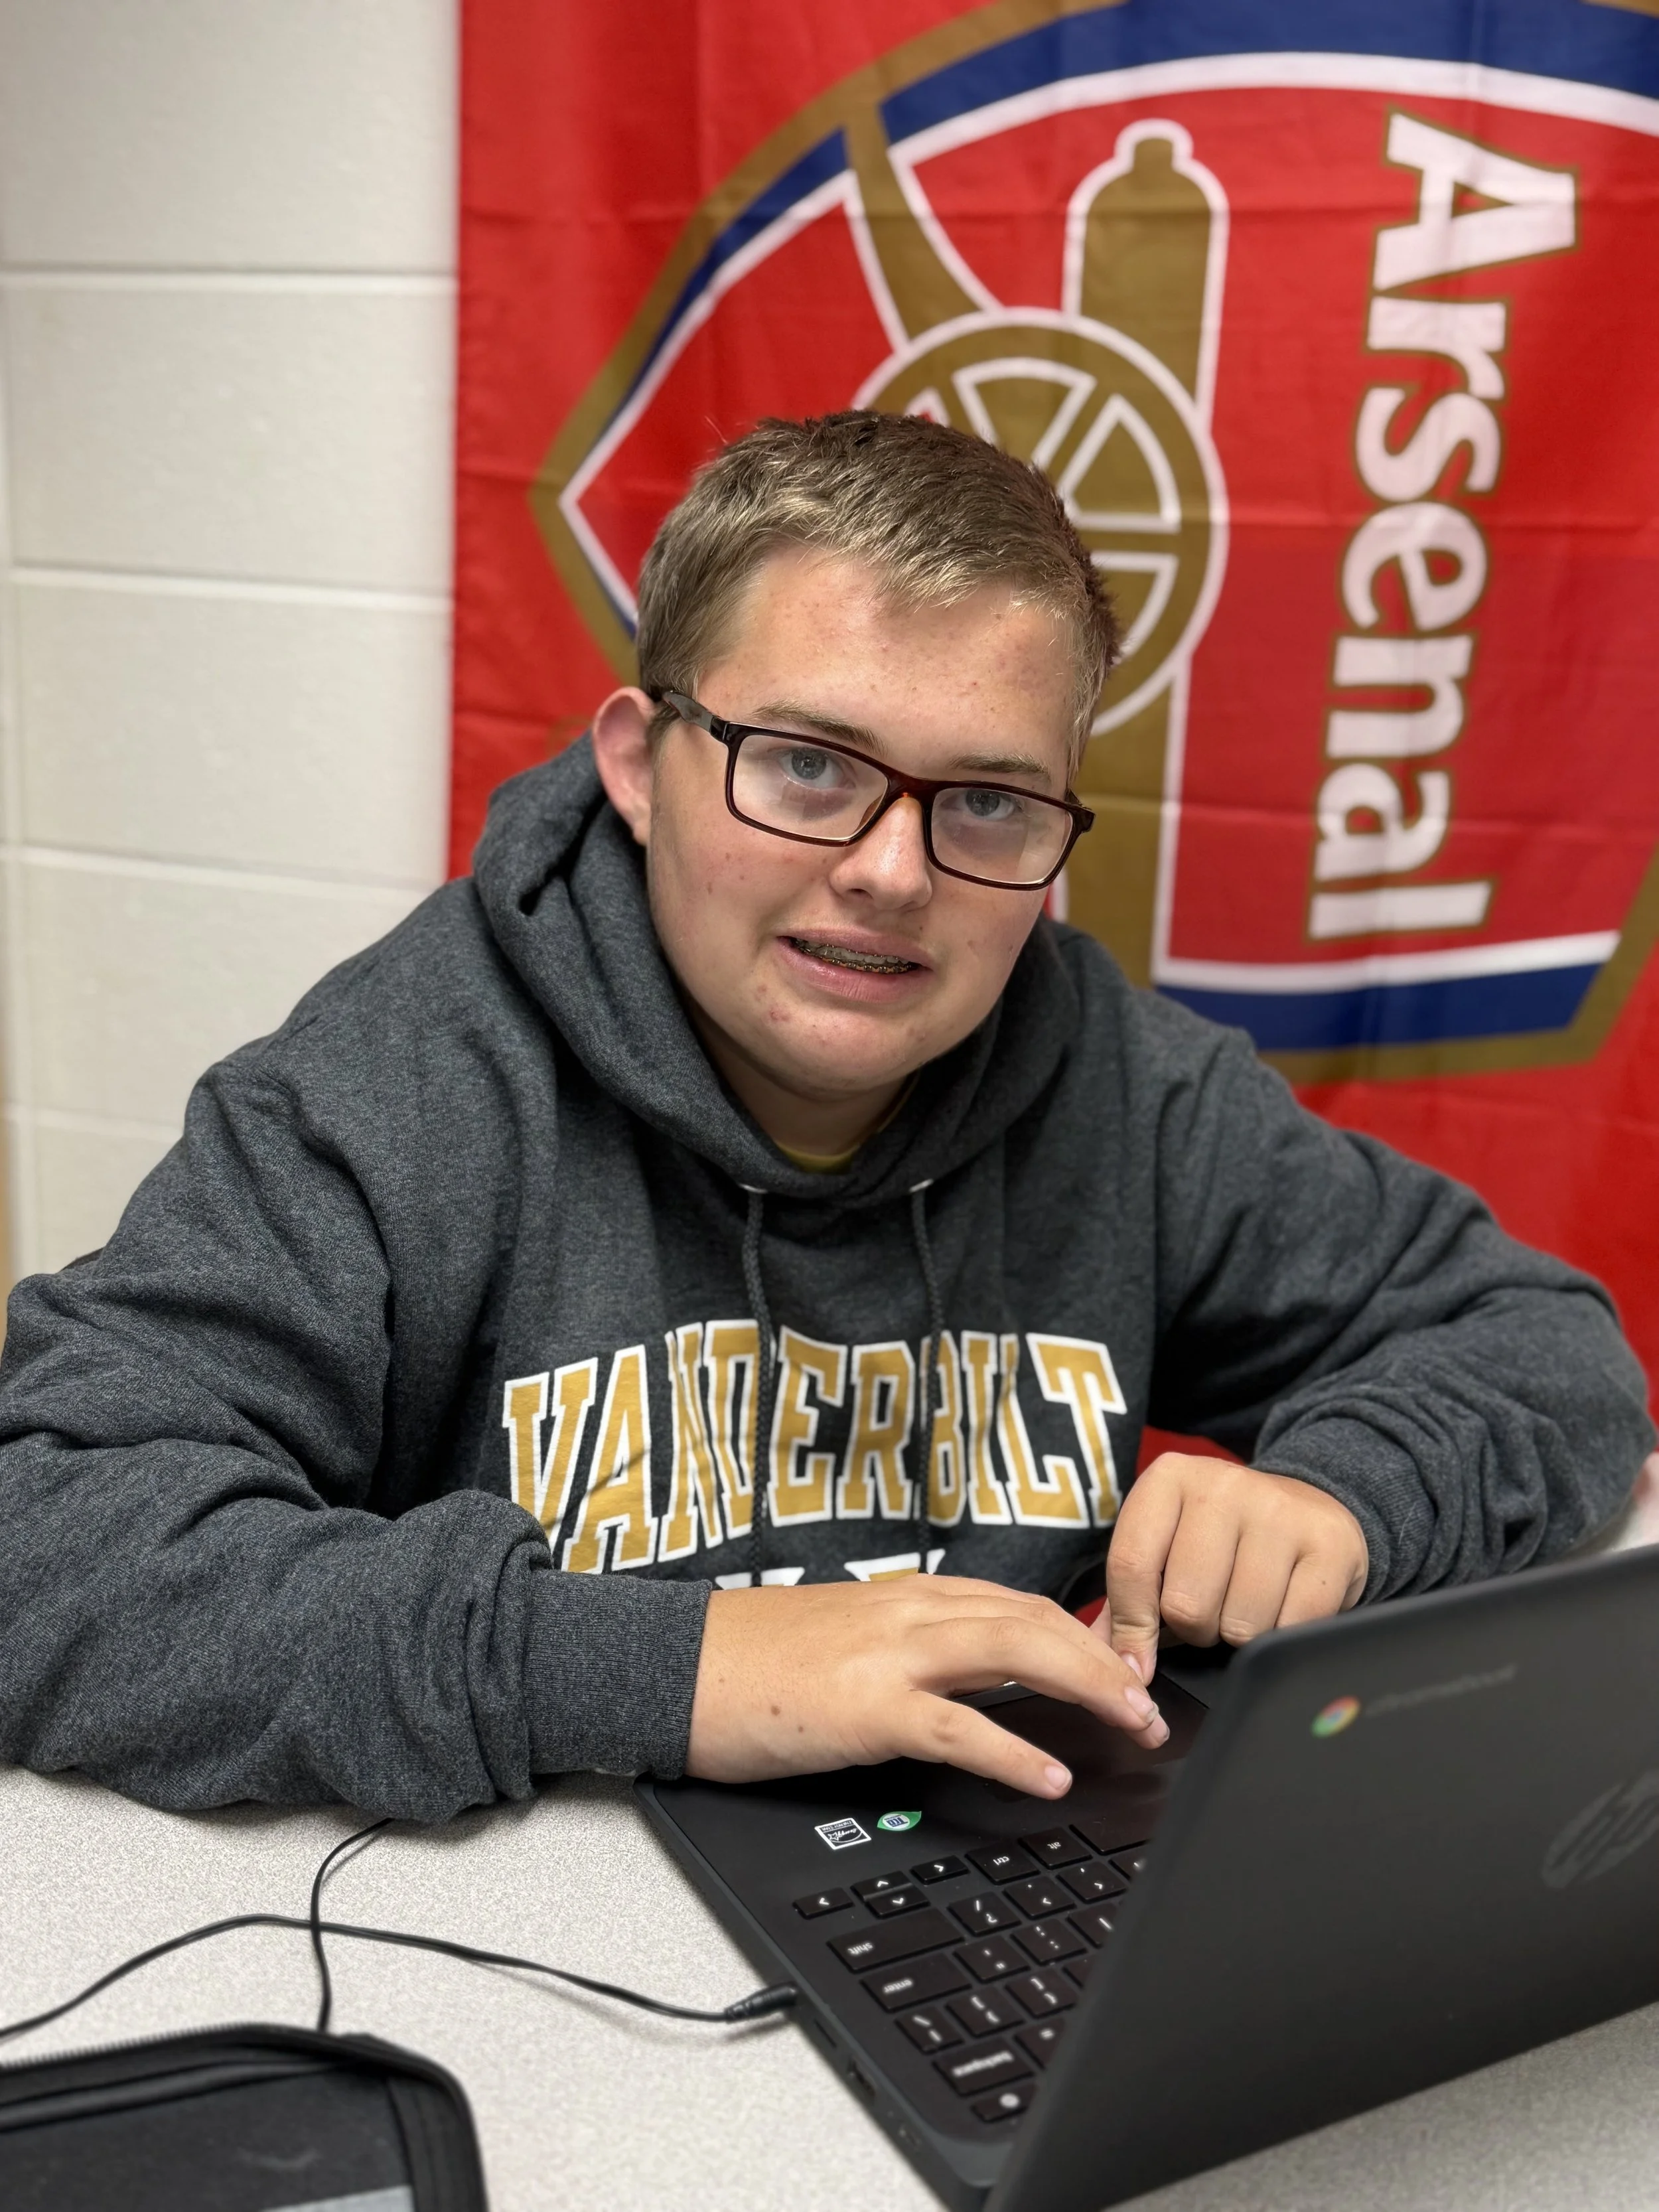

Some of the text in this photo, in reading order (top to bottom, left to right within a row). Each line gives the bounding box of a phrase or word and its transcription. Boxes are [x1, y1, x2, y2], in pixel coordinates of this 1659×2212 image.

[1306, 108, 1578, 941] Arsenal
[502, 1318, 1127, 1574] VANDERBILT
[1047, 1841, 1062, 1850] alt
[992, 1856, 1010, 1866] ctrl
[847, 1941, 874, 1956] shift
[883, 1978, 914, 1994] enter
